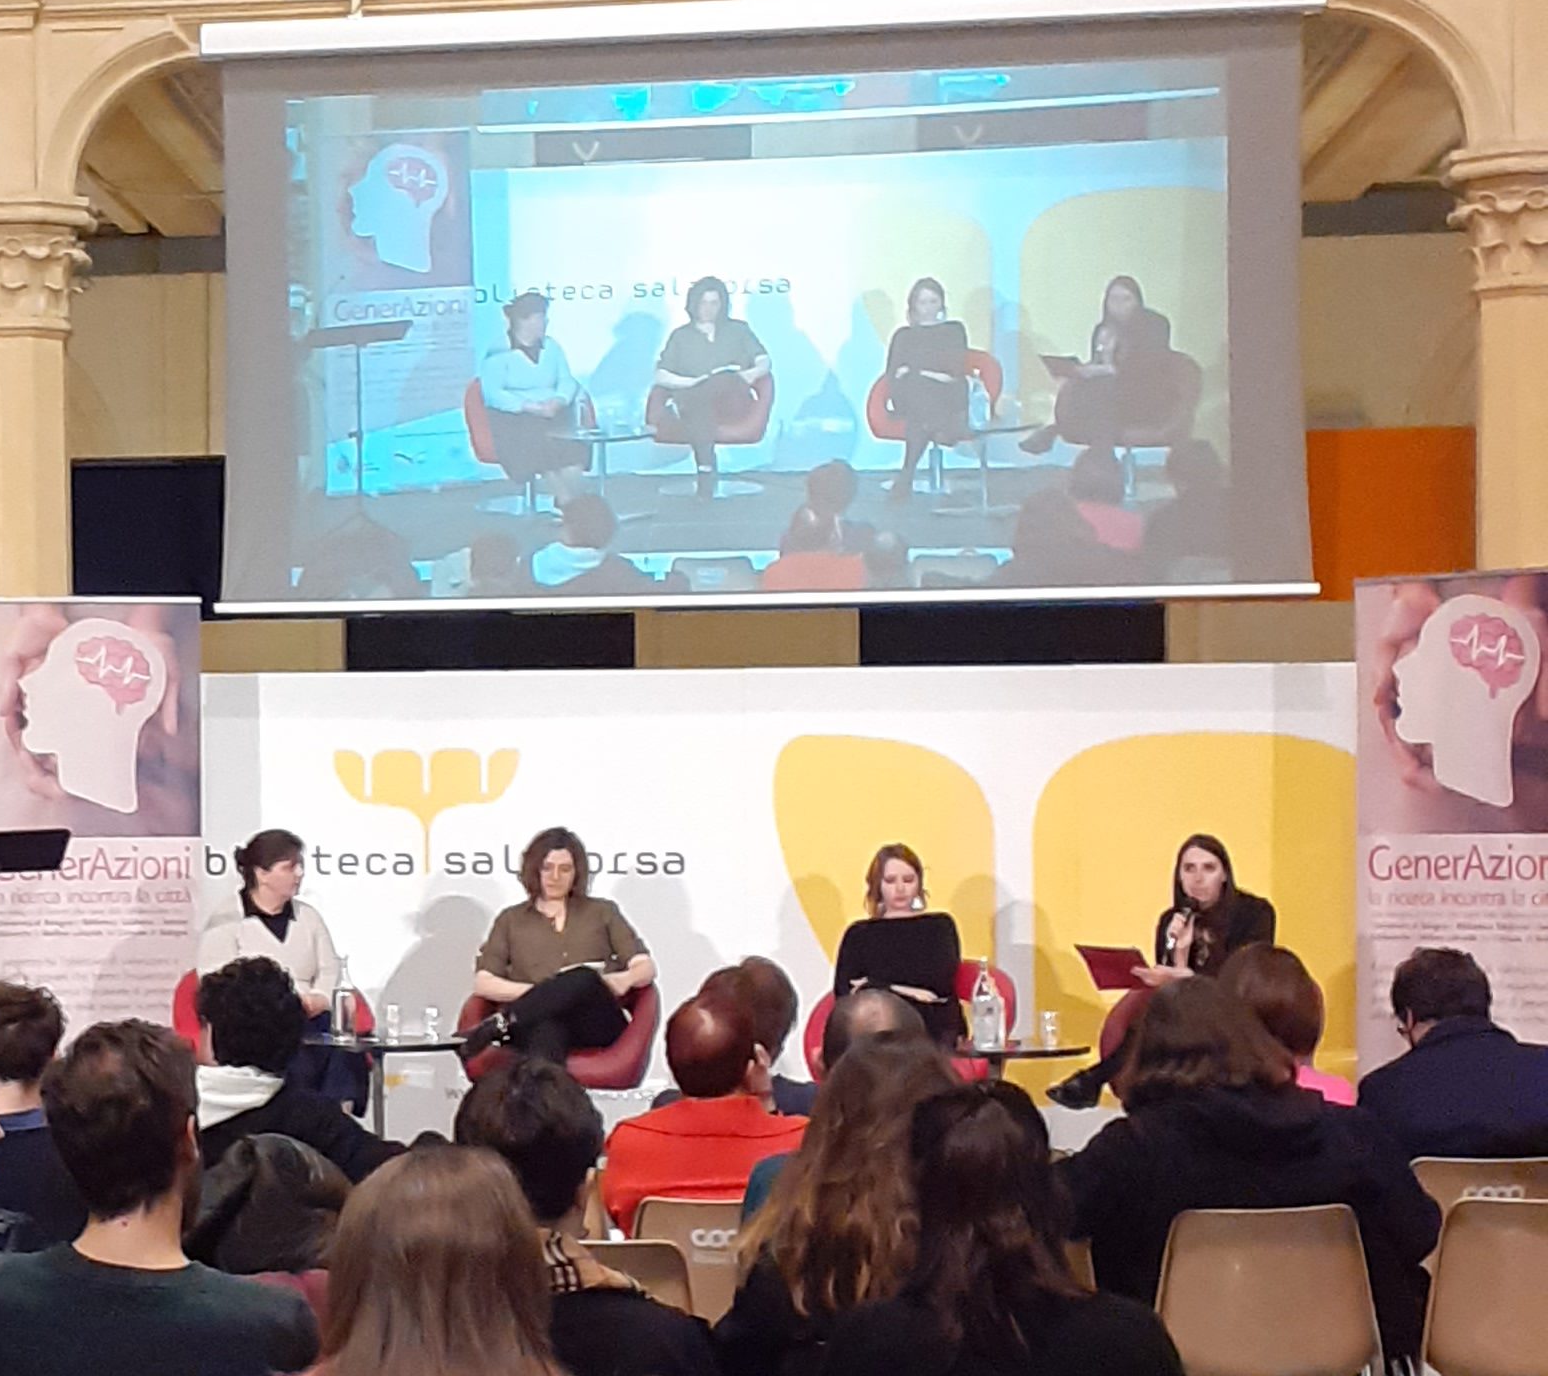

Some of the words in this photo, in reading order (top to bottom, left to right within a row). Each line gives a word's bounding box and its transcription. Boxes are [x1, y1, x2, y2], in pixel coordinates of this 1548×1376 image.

[633, 277, 791, 299] salorsa
[204, 844, 416, 876] bteca
[443, 844, 686, 876] salorsa
